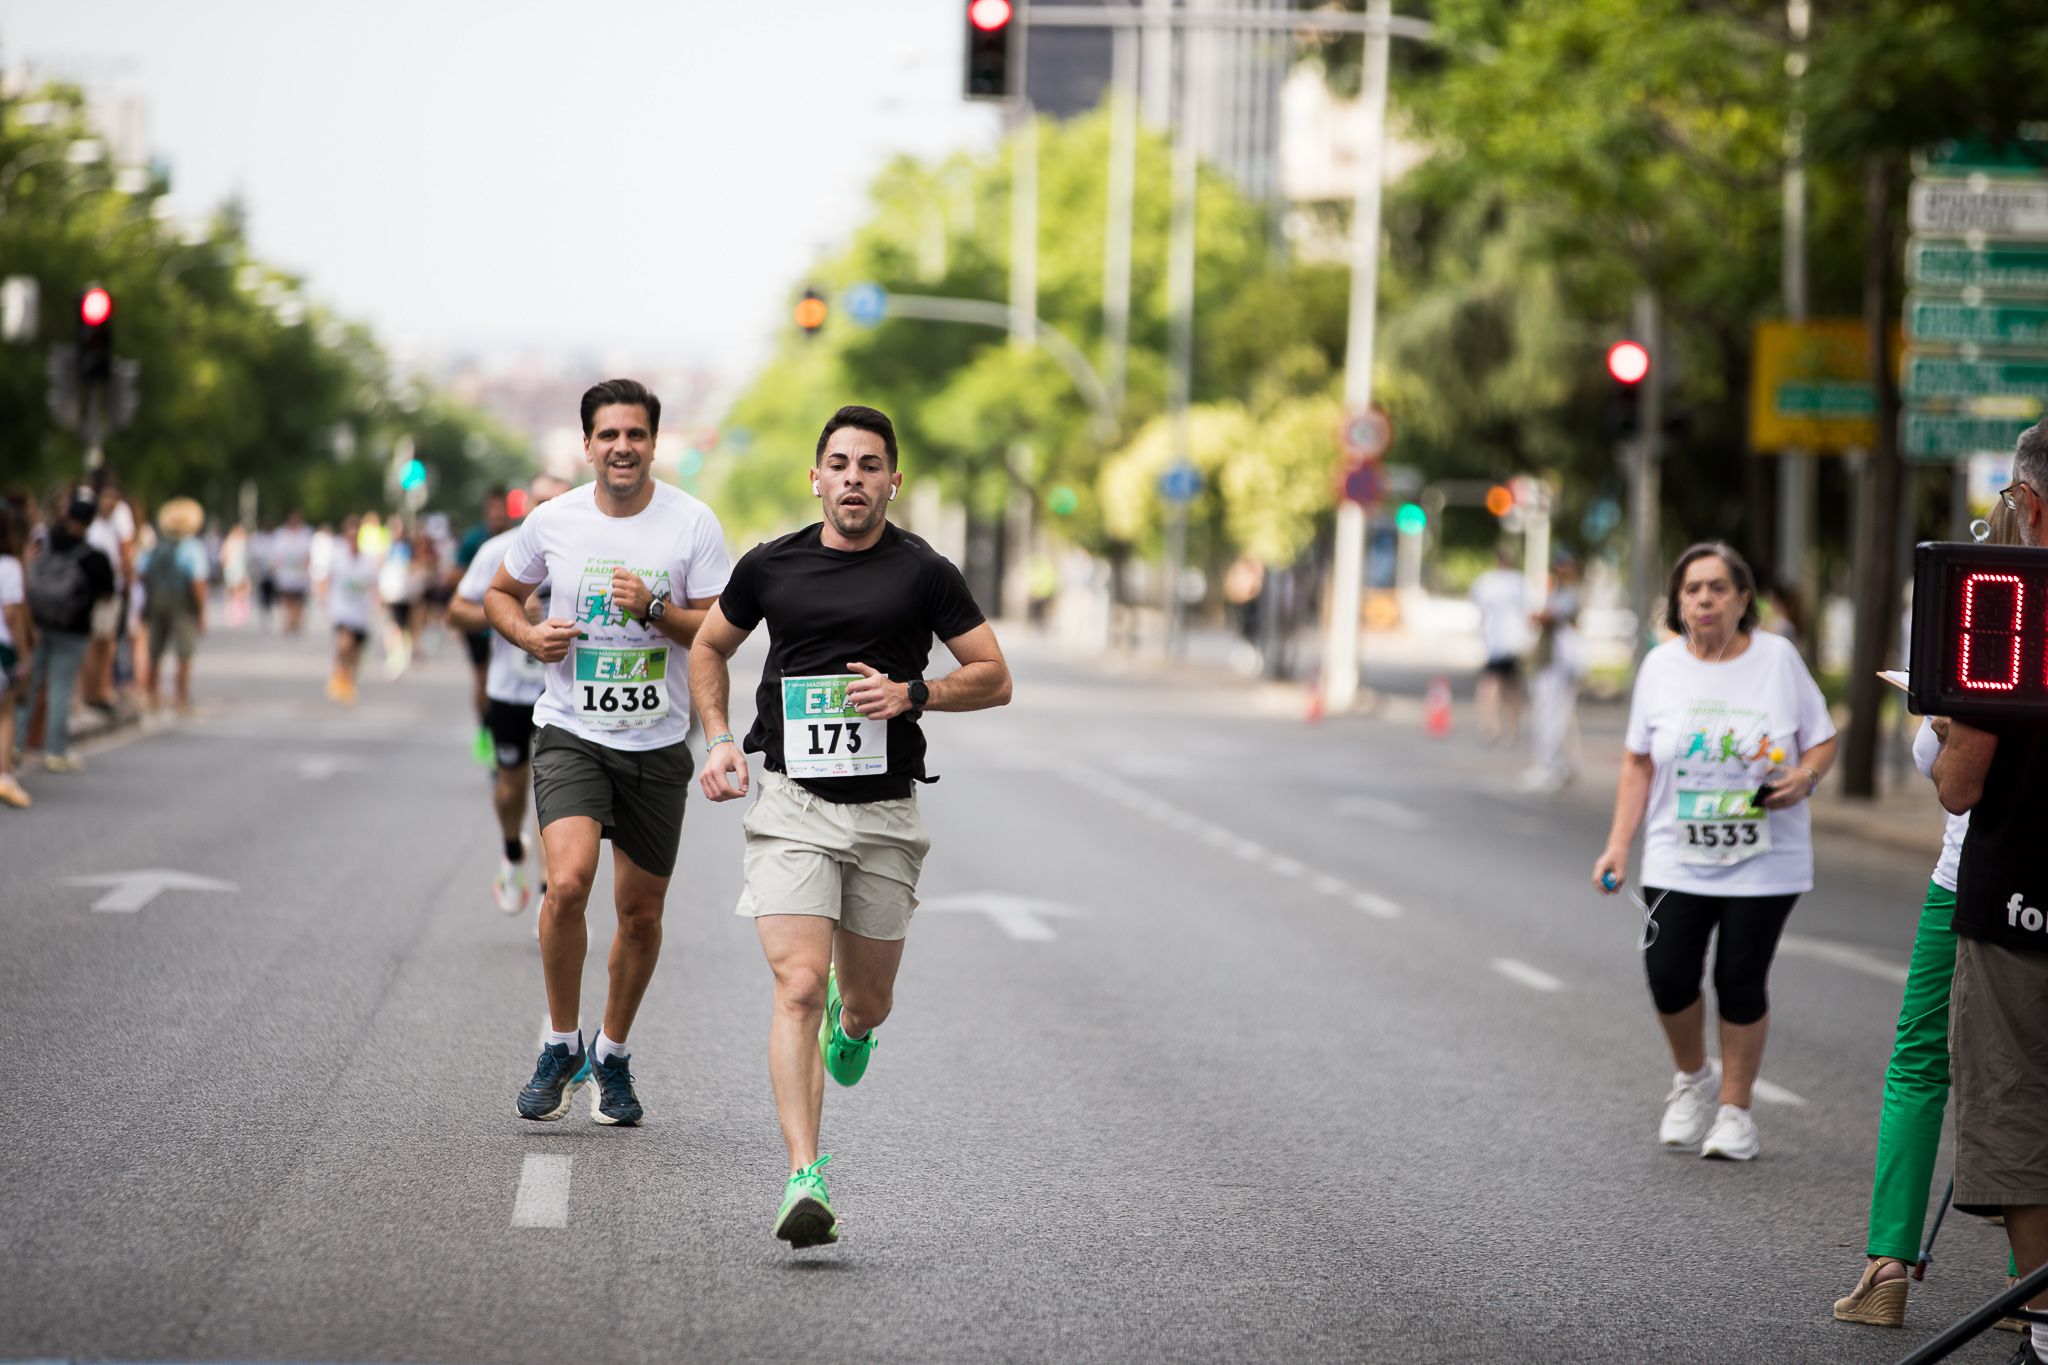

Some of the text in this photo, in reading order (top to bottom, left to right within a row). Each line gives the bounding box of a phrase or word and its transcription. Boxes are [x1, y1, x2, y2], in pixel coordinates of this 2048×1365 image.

[656, 569, 669, 577] LA
[1962, 574, 2048, 690] 0
[595, 656, 649, 679] ELA
[583, 685, 660, 712] 1638
[808, 723, 862, 755] 173
[1687, 823, 1760, 847] 1533
[2007, 893, 2048, 933] fo
